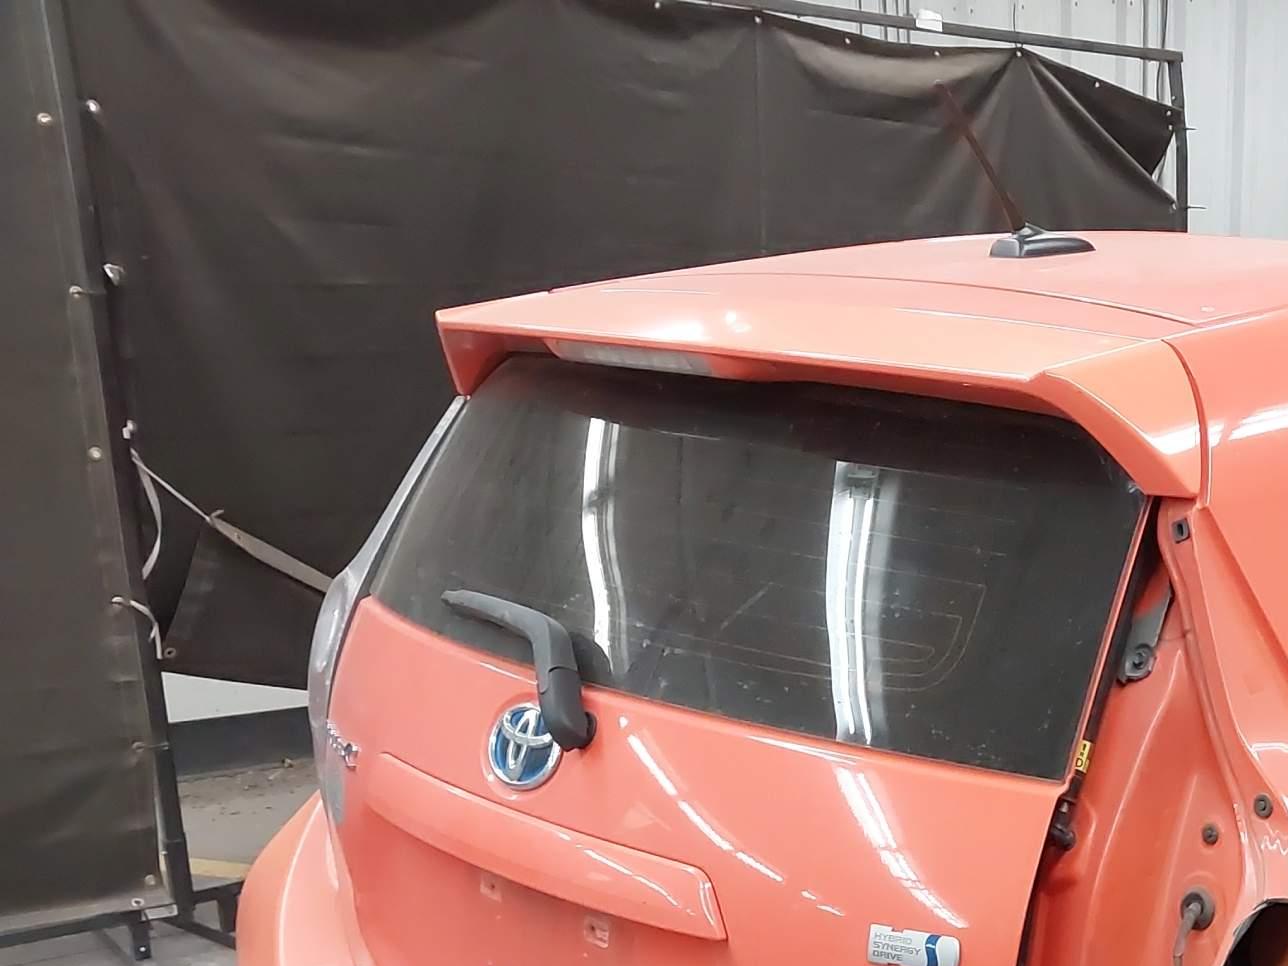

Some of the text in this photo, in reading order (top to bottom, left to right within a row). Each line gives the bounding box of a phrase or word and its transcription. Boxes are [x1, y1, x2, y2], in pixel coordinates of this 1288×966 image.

[873, 932, 912, 945] HYBRID
[872, 941, 921, 956] SYNERGY
[872, 950, 904, 962] DRIVE
